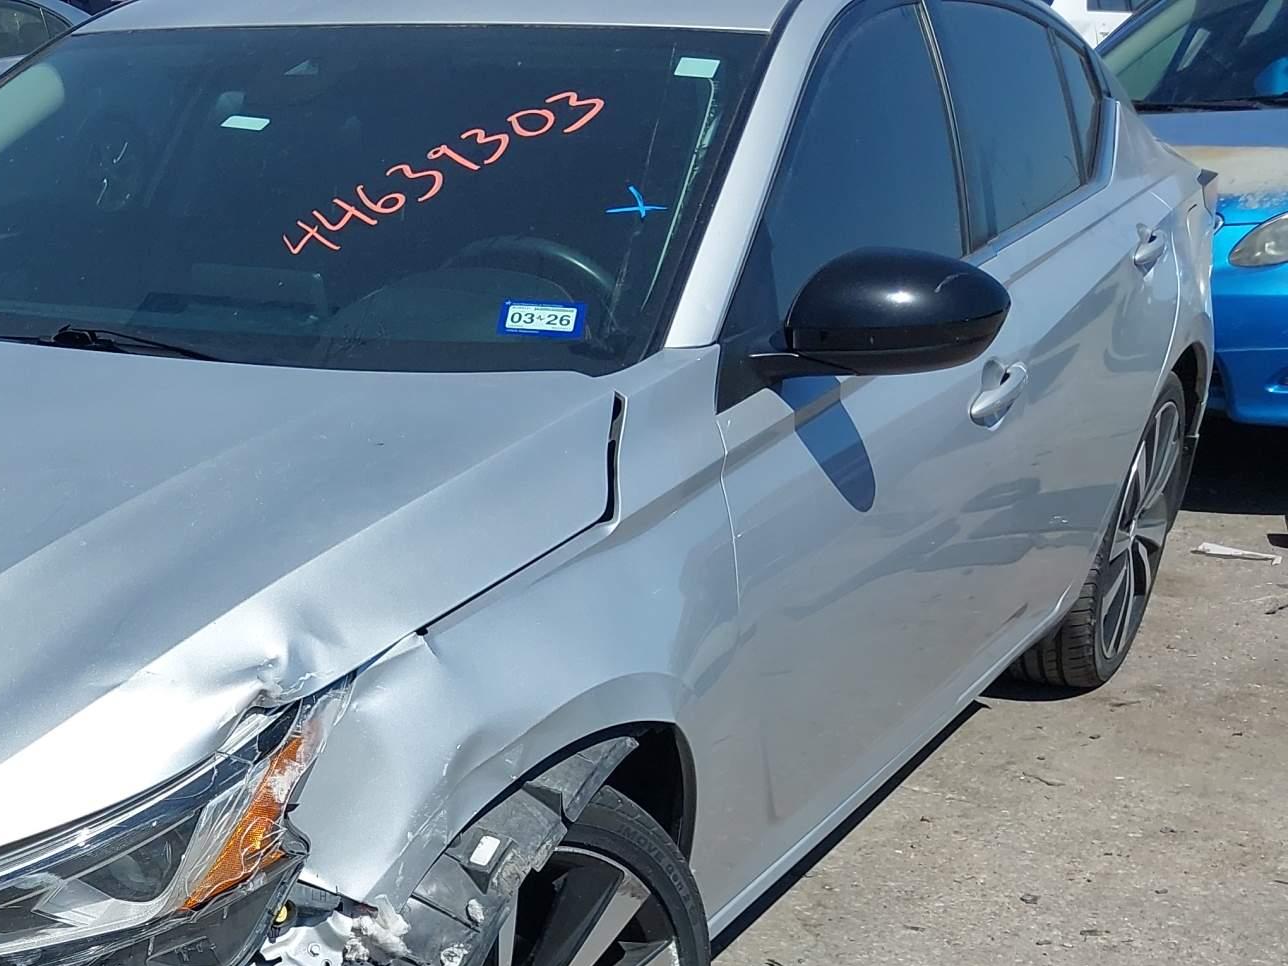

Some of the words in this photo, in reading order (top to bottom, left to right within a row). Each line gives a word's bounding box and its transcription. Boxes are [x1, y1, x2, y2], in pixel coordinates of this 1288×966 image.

[282, 92, 605, 255] 44639303
[510, 311, 535, 325] 03
[545, 313, 572, 327] 26
